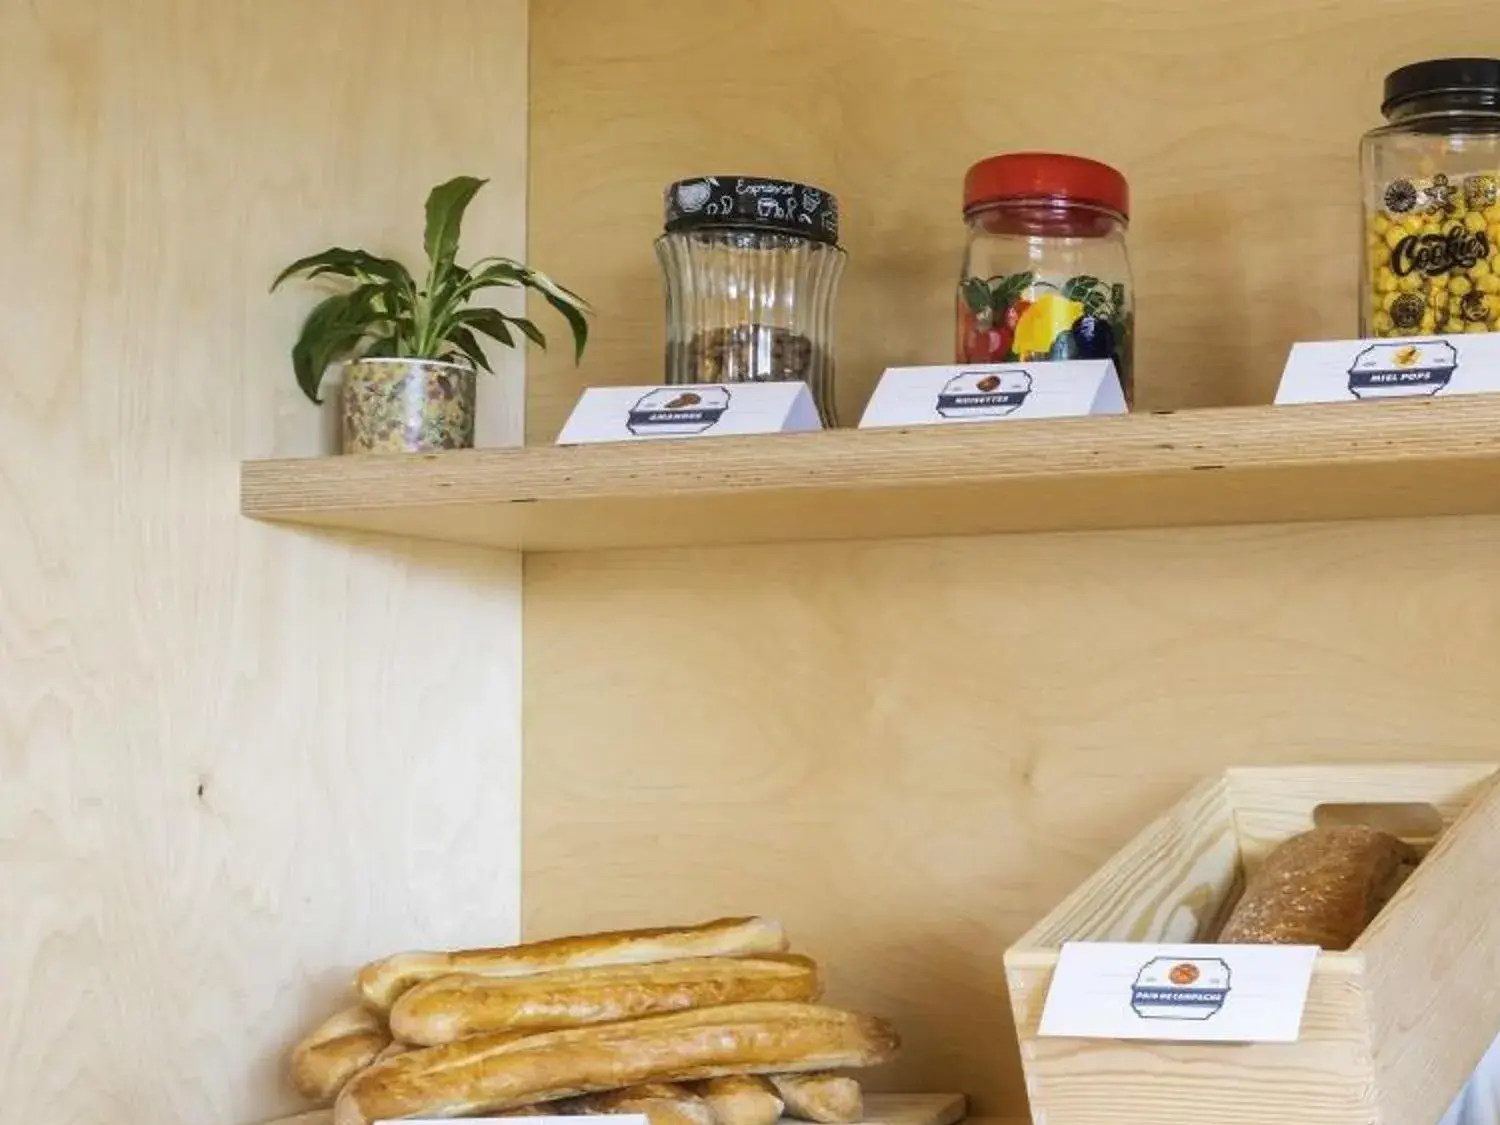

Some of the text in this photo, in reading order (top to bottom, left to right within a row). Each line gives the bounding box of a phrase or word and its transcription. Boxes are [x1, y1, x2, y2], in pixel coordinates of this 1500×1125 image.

[1391, 225, 1490, 277] Cookies
[1369, 371, 1432, 383] MIEL POPS
